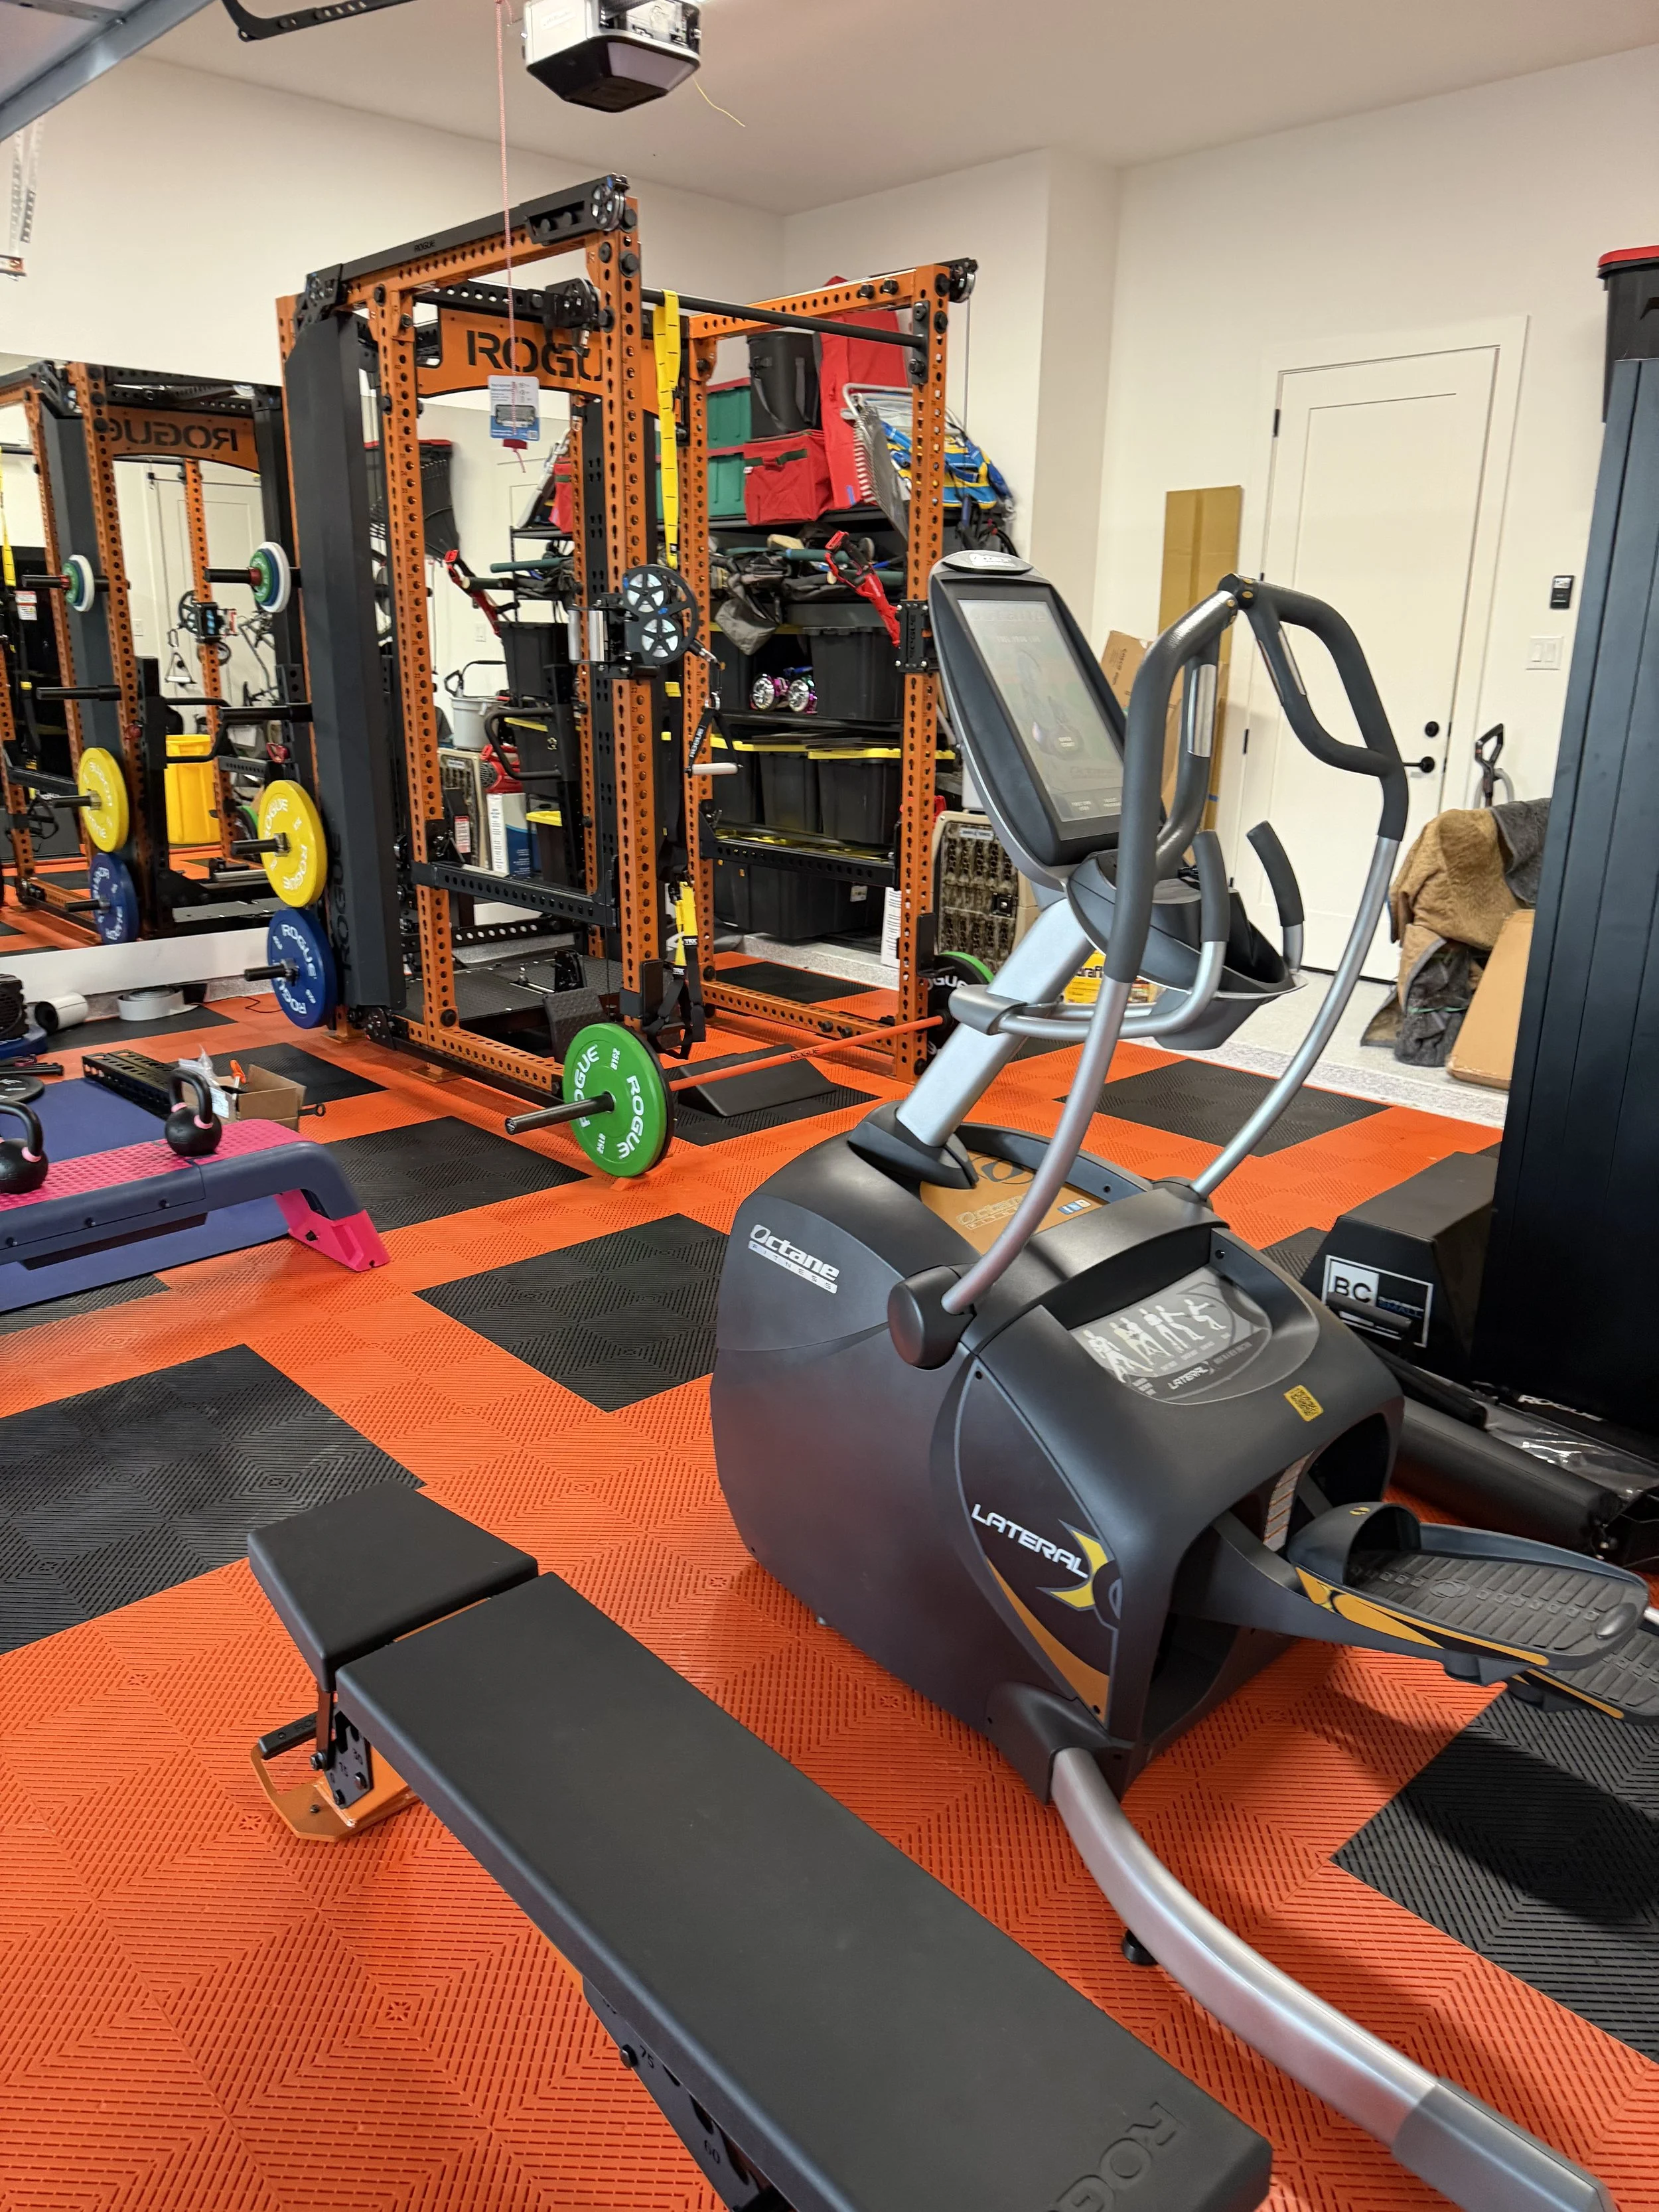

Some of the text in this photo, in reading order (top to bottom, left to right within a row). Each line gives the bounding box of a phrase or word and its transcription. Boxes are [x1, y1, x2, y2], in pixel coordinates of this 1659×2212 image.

[467, 330, 603, 382] ROGU
[281, 924, 316, 977] ROGUE
[616, 1075, 644, 1159] ROGUE
[956, 1194, 1026, 1225] Octan
[751, 1224, 839, 1281] Octane
[752, 1243, 832, 1290] FITNESS
[1334, 1276, 1372, 1303] BC
[971, 1504, 1089, 1580] LATERAL
[640, 2045, 654, 2068] 75
[704, 2140, 720, 2164] 60
[1054, 2101, 1186, 2212] ROG
